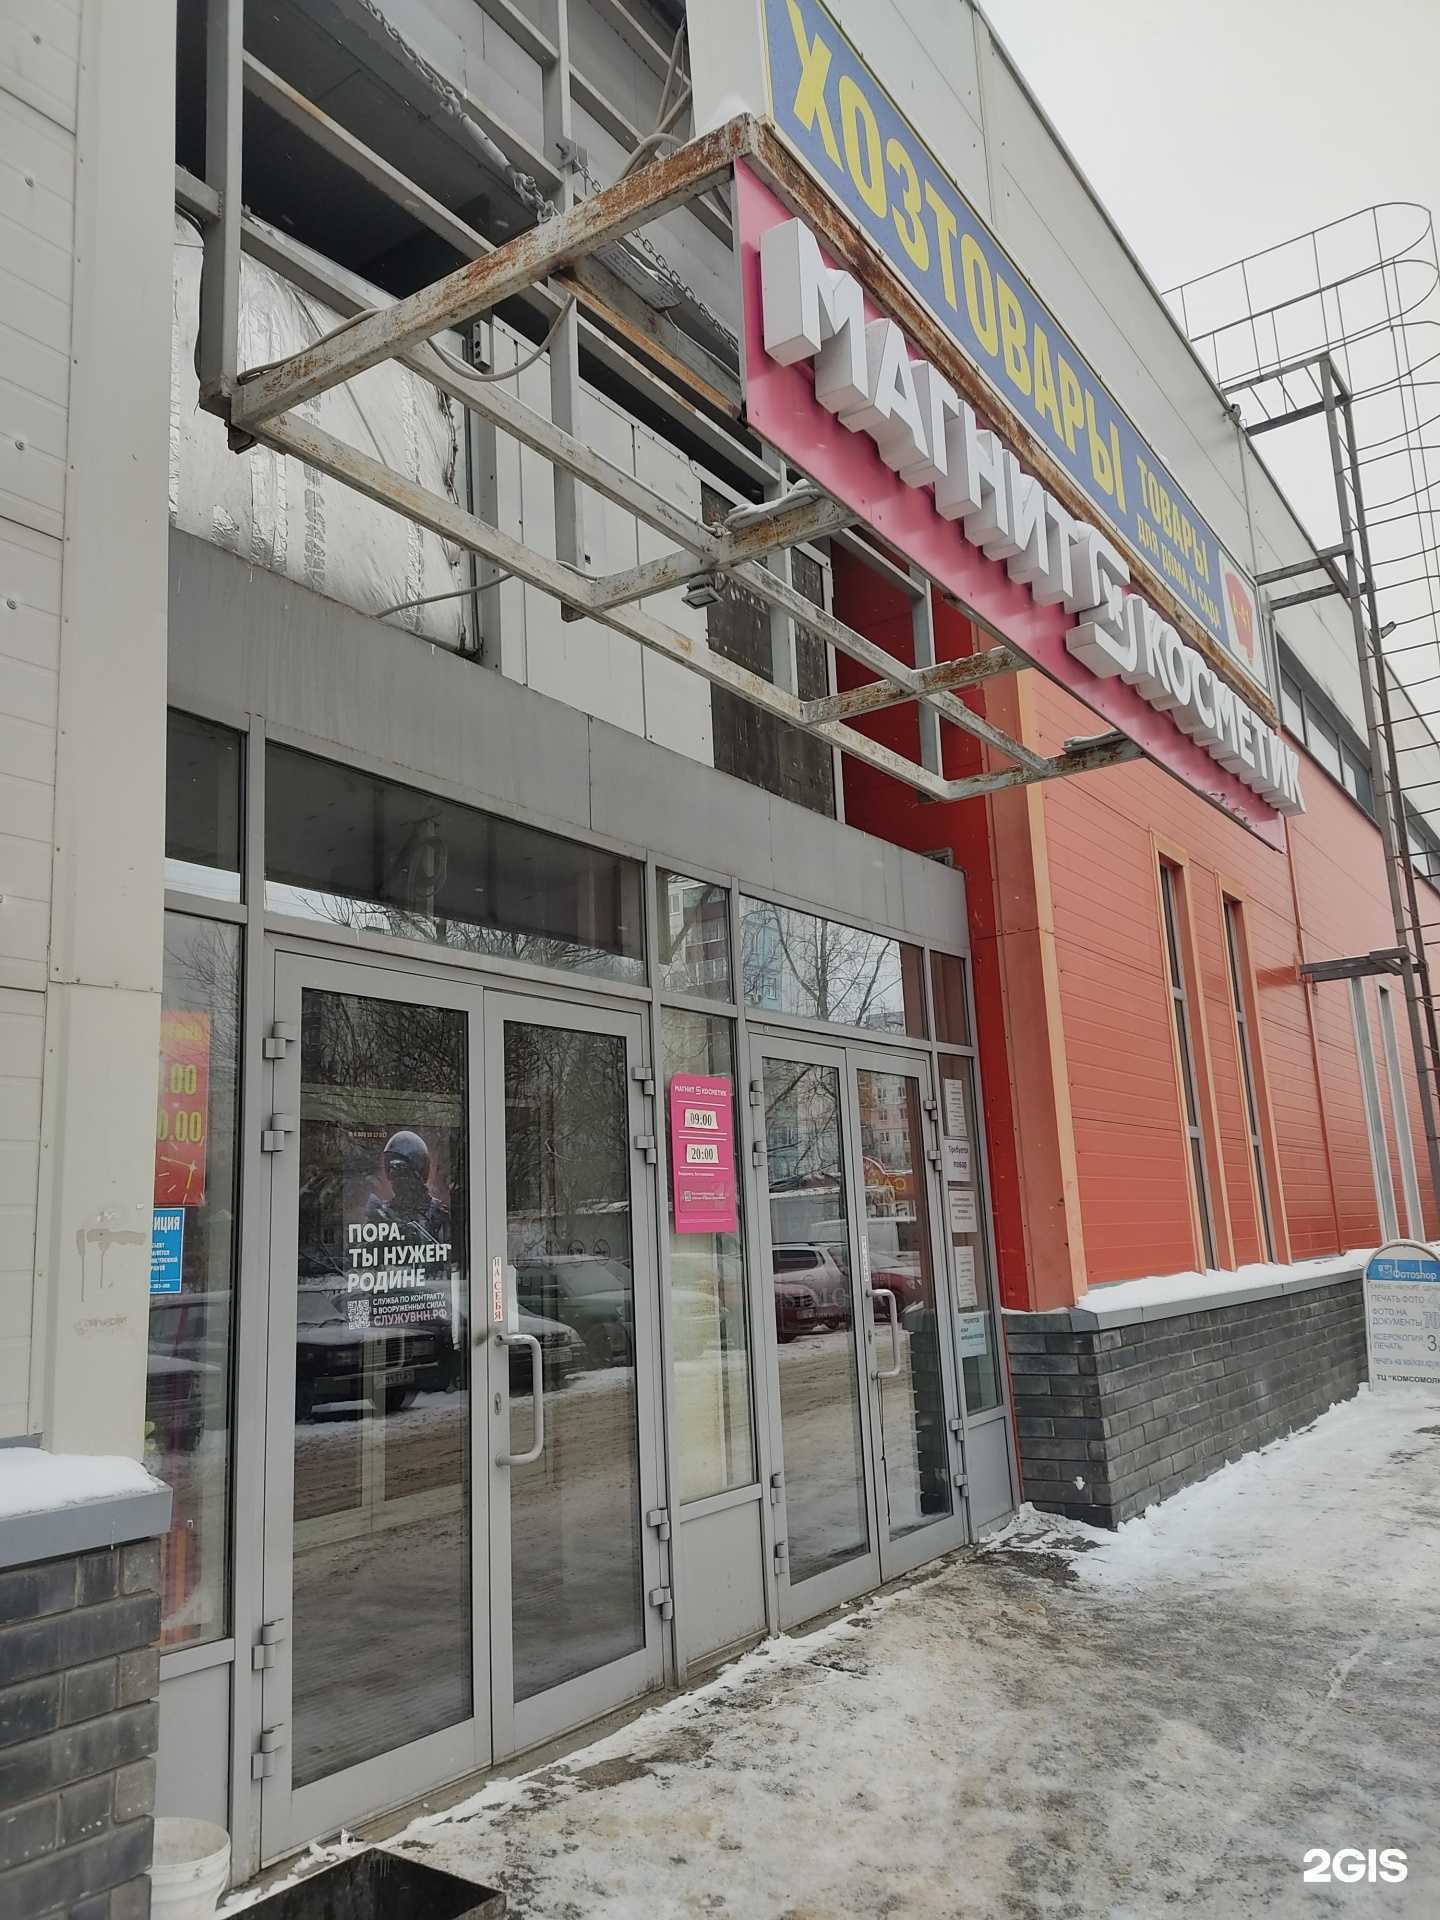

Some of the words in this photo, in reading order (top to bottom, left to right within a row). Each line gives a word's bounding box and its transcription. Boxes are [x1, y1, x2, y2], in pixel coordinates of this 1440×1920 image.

[788, 0, 1127, 515] ХОЗТОВАРЫ
[760, 217, 1078, 606] МАГНИТ
[1136, 455, 1210, 585] ТОВАРЫ
[1161, 542, 1190, 596] ДОМА
[1197, 586, 1222, 630] САДА
[1121, 598, 1306, 816] КОСМЕТИК
[690, 1112, 713, 1127] 09:00
[691, 1147, 714, 1160] 20:00
[348, 1222, 406, 1243] ПОРА.
[348, 1247, 378, 1268] ТЫ
[383, 1244, 448, 1266] НУЖЕН
[347, 1268, 426, 1294] РОДИНЕ
[373, 1297, 399, 1306] СЛУЖБА
[399, 1295, 410, 1303] ПО
[410, 1292, 445, 1303] КОНТРАКТУ
[373, 1307, 378, 1315] В
[378, 1304, 426, 1314] ВООРУЖЕННЫХ
[426, 1300, 447, 1310] СИЛАХ
[1372, 1317, 1423, 1328] ДОКУМЕНТЫ
